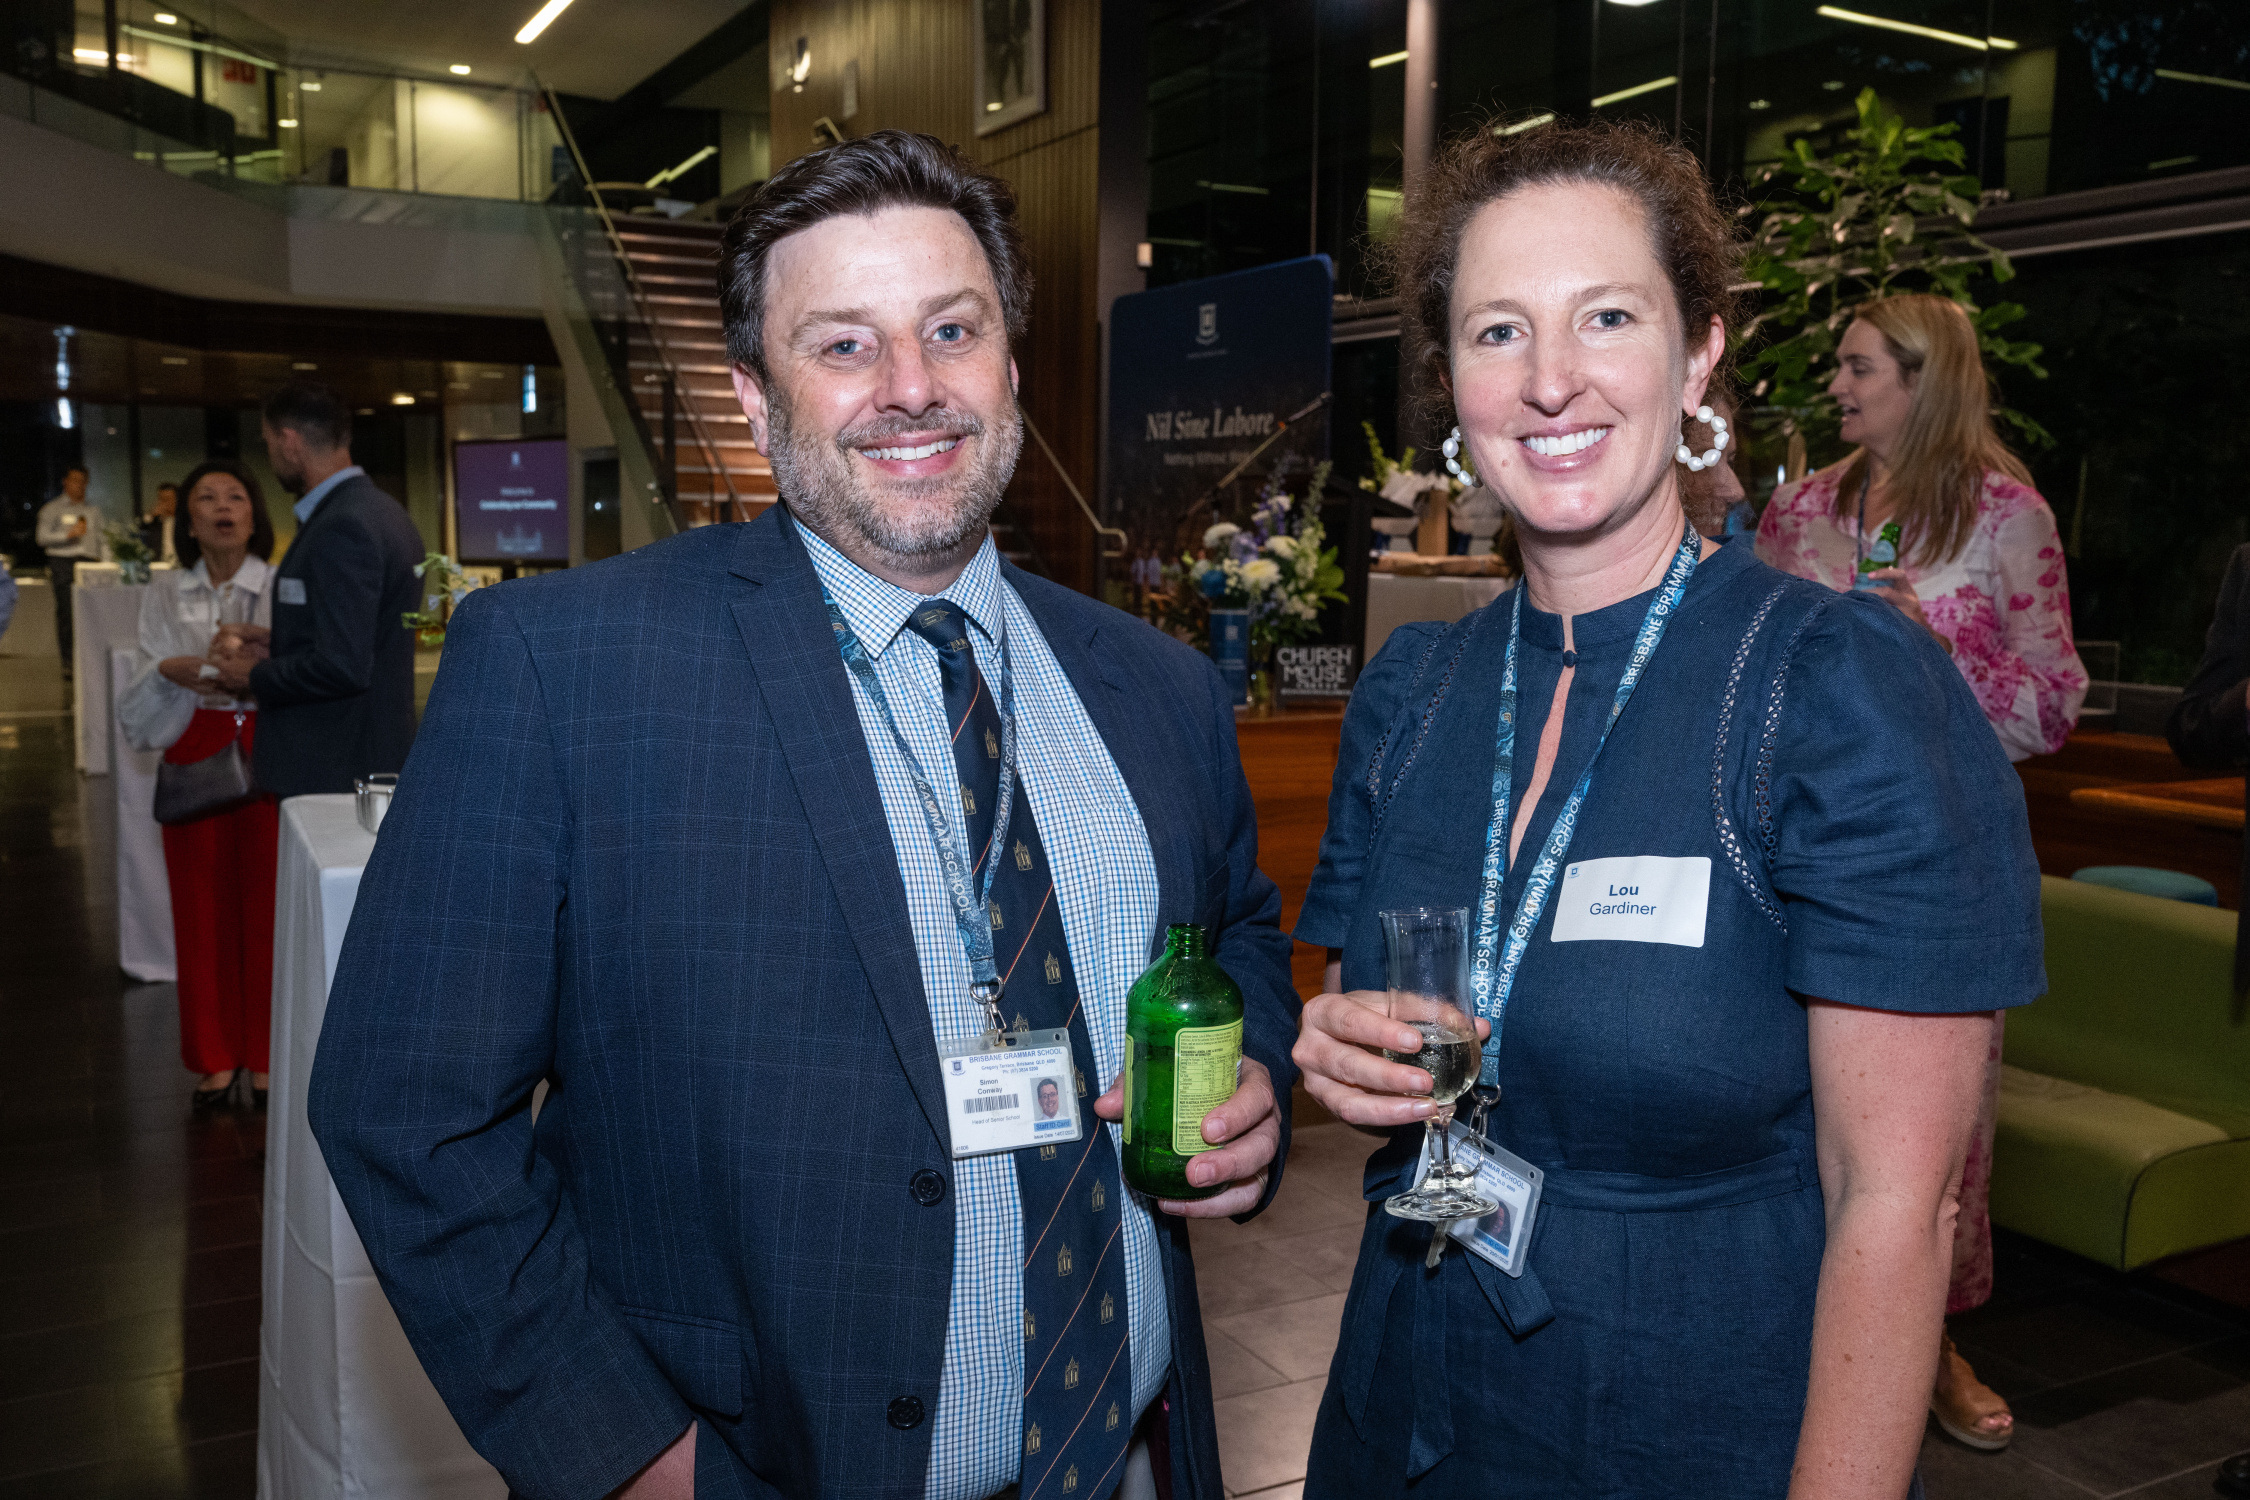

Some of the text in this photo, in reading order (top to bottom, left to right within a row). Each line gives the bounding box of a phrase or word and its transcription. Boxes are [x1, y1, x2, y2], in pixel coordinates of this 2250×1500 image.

[1174, 410, 1211, 441] Sine
[1212, 406, 1274, 438] Labore
[1623, 546, 1695, 685] BRISBANE GRAMMAR
[1276, 647, 1352, 667] CHURCH
[1504, 637, 1516, 693] SCHOOL
[1283, 665, 1347, 683] MOUSE
[995, 714, 1014, 841] GRAMMAR SCHOOL
[943, 851, 972, 916] SCHOOL
[1608, 884, 1639, 897] Lou
[1476, 798, 1505, 1016] BRISBANE GRAMMAR SCHOOL
[1490, 796, 1582, 1019] BRISBANE GRAMMAR SCHOOL
[1589, 901, 1657, 916] Gardiner
[969, 1048, 1062, 1064] BRISBANE GRAMMAR SCHOOL
[977, 1087, 1003, 1096] Conway
[979, 1078, 999, 1086] Simon
[1035, 1122, 1049, 1130] Staff
[1056, 1119, 1070, 1128] Card
[1500, 1170, 1525, 1190] SCHOOL
